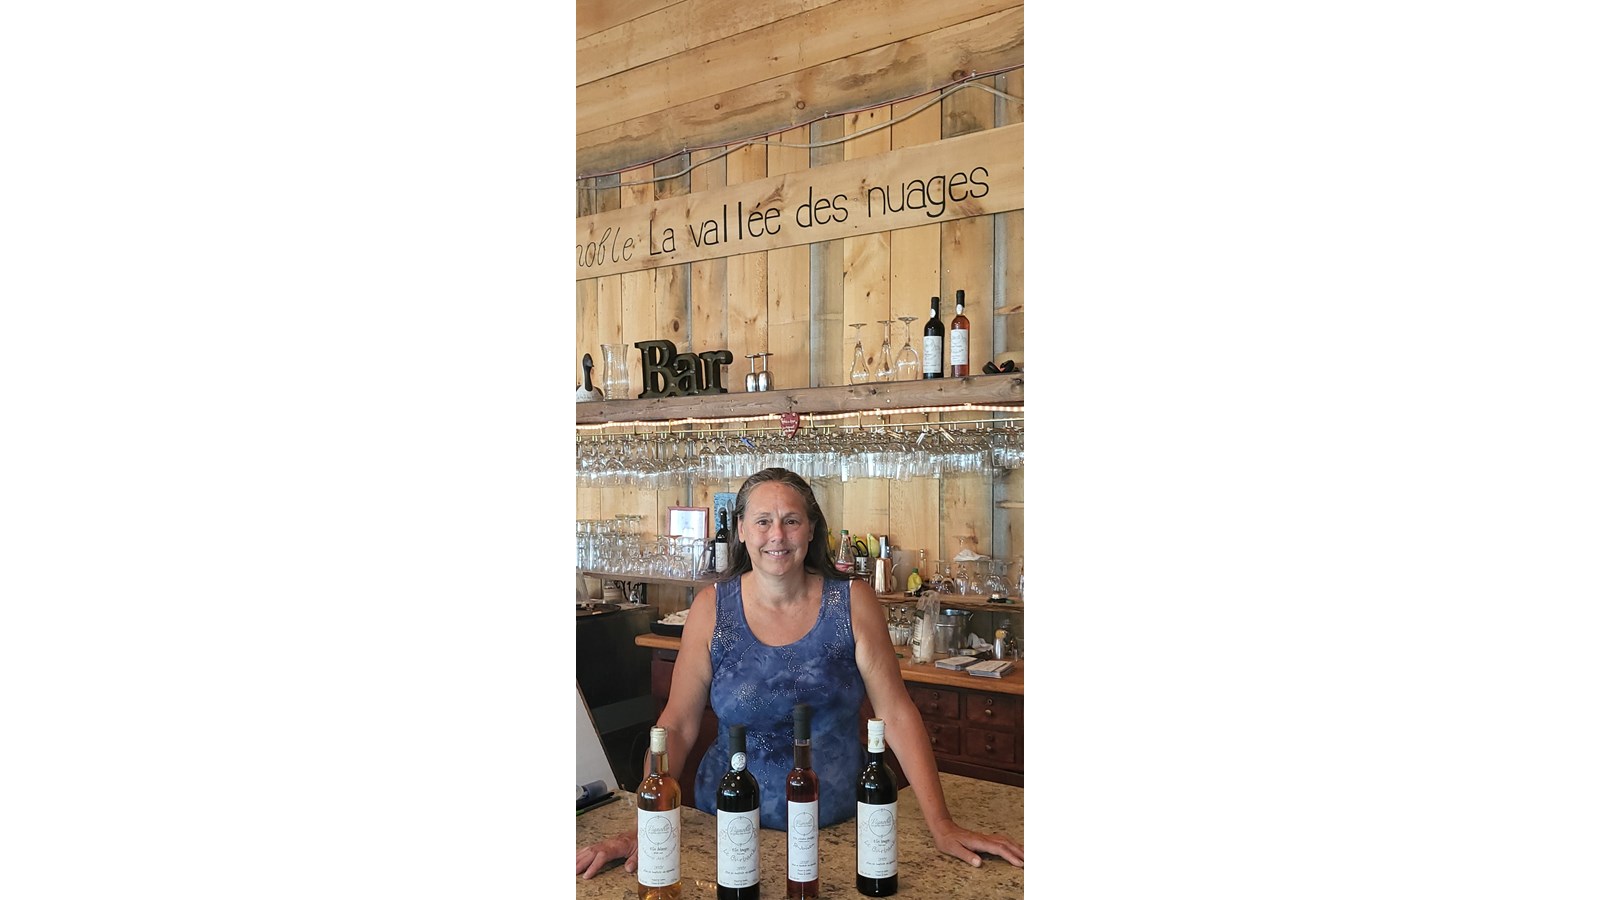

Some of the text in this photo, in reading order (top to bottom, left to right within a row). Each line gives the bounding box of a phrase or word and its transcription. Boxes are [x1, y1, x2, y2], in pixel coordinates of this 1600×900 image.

[648, 219, 677, 256] La
[689, 201, 781, 248] vallée
[795, 186, 849, 229] des
[866, 166, 990, 219] nuages
[634, 340, 734, 399] Bar
